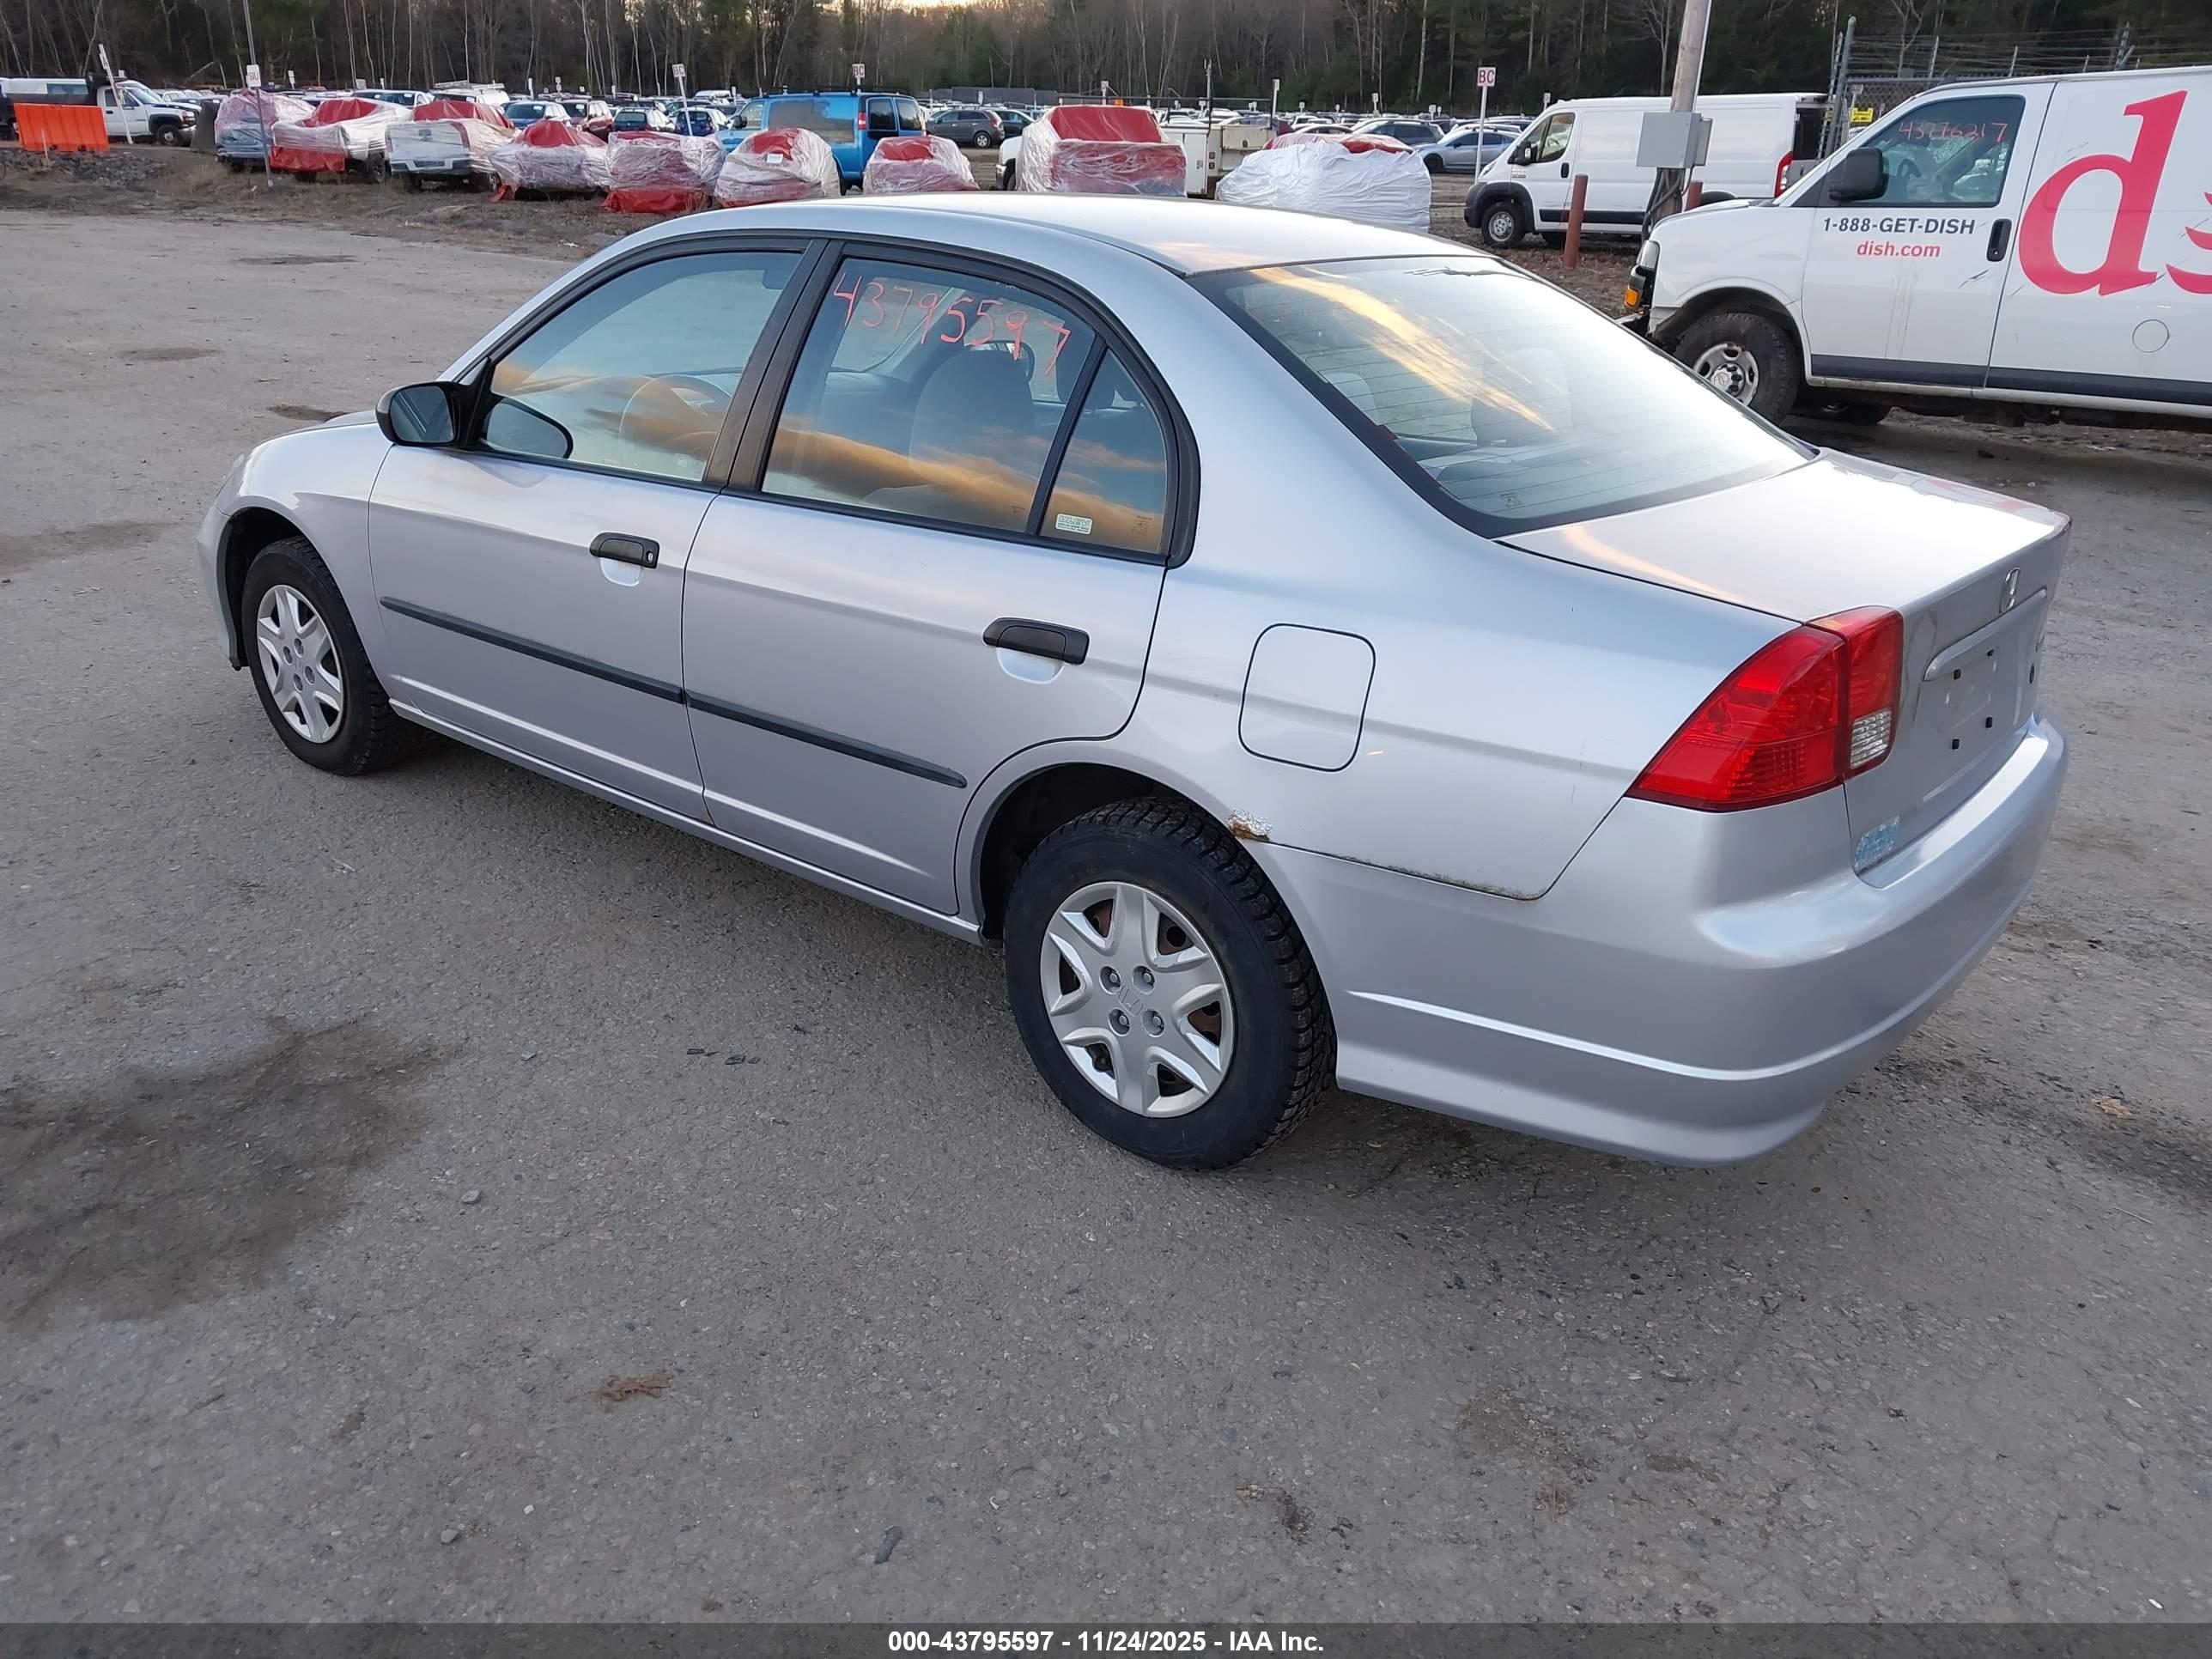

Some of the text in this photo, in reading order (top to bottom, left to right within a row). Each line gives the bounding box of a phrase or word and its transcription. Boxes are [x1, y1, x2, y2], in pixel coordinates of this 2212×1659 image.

[854, 65, 864, 76] BC
[1479, 70, 1495, 83] BC
[1823, 216, 1976, 235] 1-888-GET-DISH
[1856, 240, 1941, 258] dish.com
[832, 272, 1072, 376] 43795597
